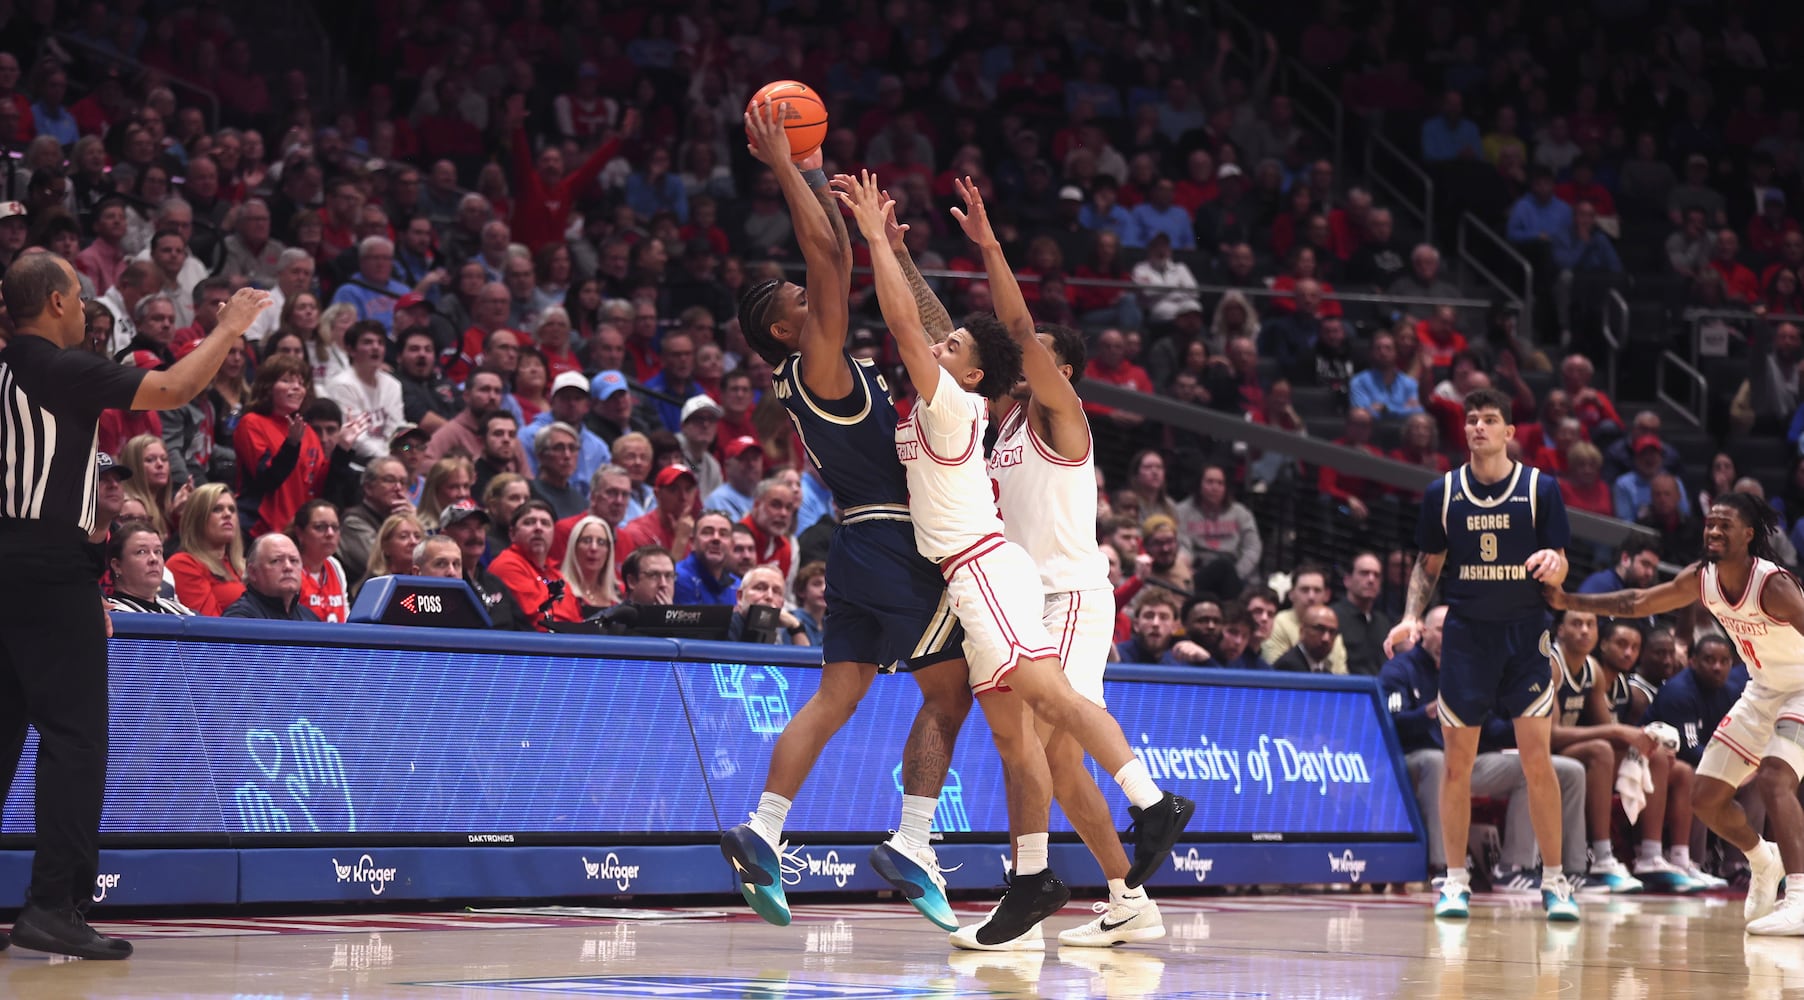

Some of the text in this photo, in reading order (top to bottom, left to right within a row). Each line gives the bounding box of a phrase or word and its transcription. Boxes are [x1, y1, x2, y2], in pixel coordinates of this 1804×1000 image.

[1467, 514, 1510, 530] GEORGE
[1480, 532, 1498, 562] 9
[417, 595, 442, 613] POSS
[1130, 733, 1371, 796] niversity of Dayton
[468, 834, 515, 843] DAKTRONICS
[354, 854, 396, 895] Kroger
[600, 853, 639, 891] Kroger
[822, 850, 856, 888] Kroger
[1184, 847, 1214, 882] Kroger
